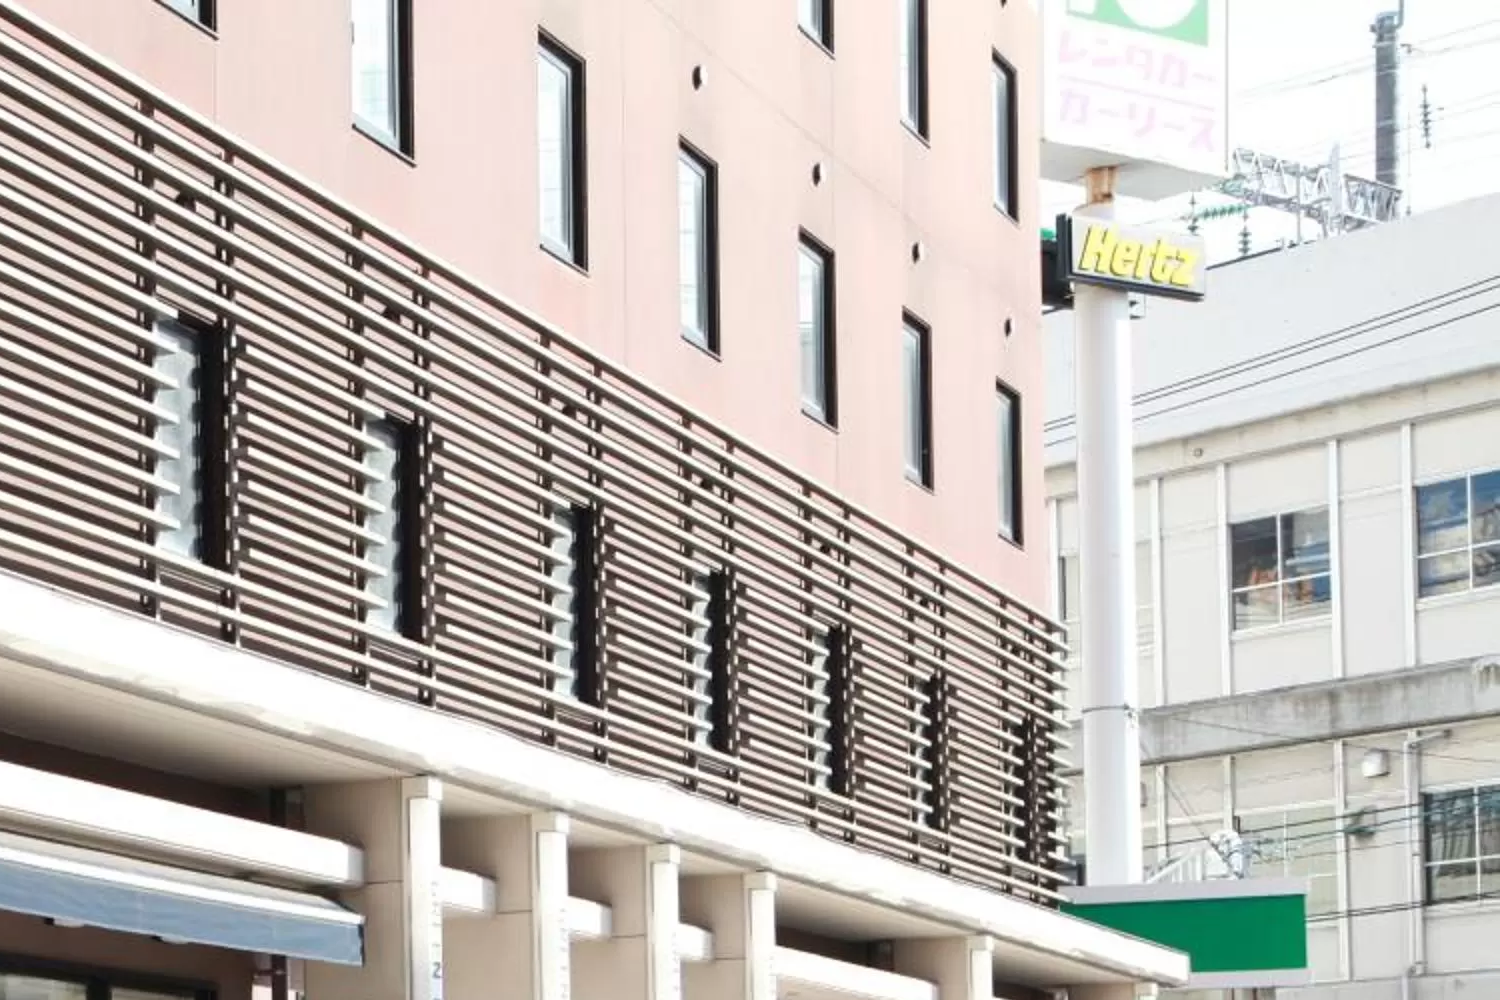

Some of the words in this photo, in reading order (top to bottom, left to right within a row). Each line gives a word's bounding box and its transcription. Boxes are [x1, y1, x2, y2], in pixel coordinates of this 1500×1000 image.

[1058, 30, 1218, 90] レンタカー
[1057, 88, 1216, 152] カーリース
[1078, 225, 1197, 286] Hertz
